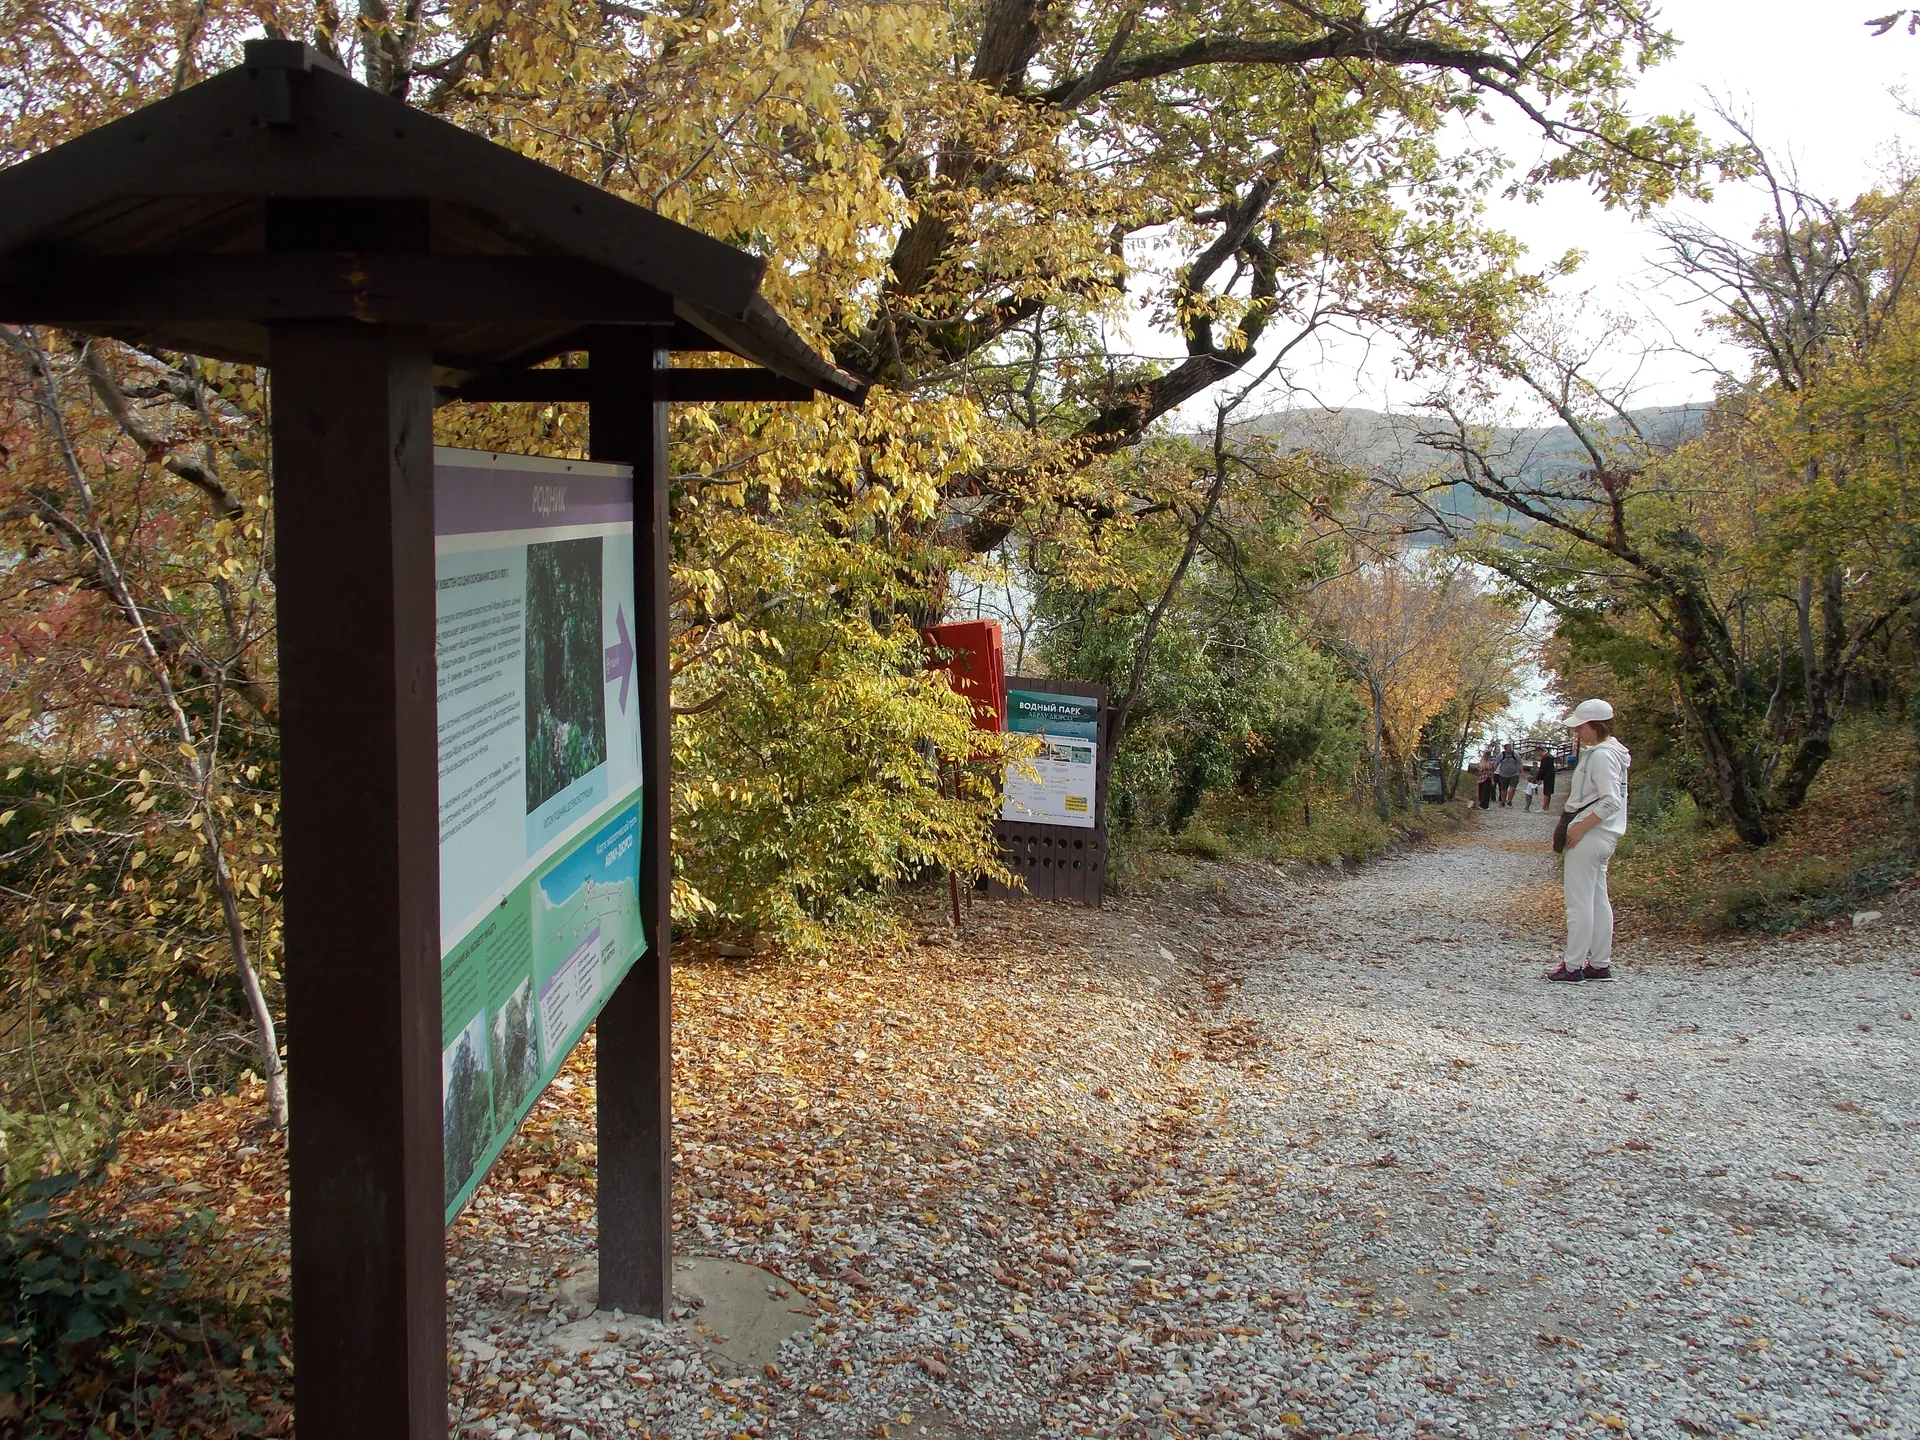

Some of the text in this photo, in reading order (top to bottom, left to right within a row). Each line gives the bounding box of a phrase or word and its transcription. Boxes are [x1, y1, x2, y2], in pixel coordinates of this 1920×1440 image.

[532, 485, 566, 518] РОДНИК
[1019, 701, 1081, 715] ВОДНЫЙ ПАРК
